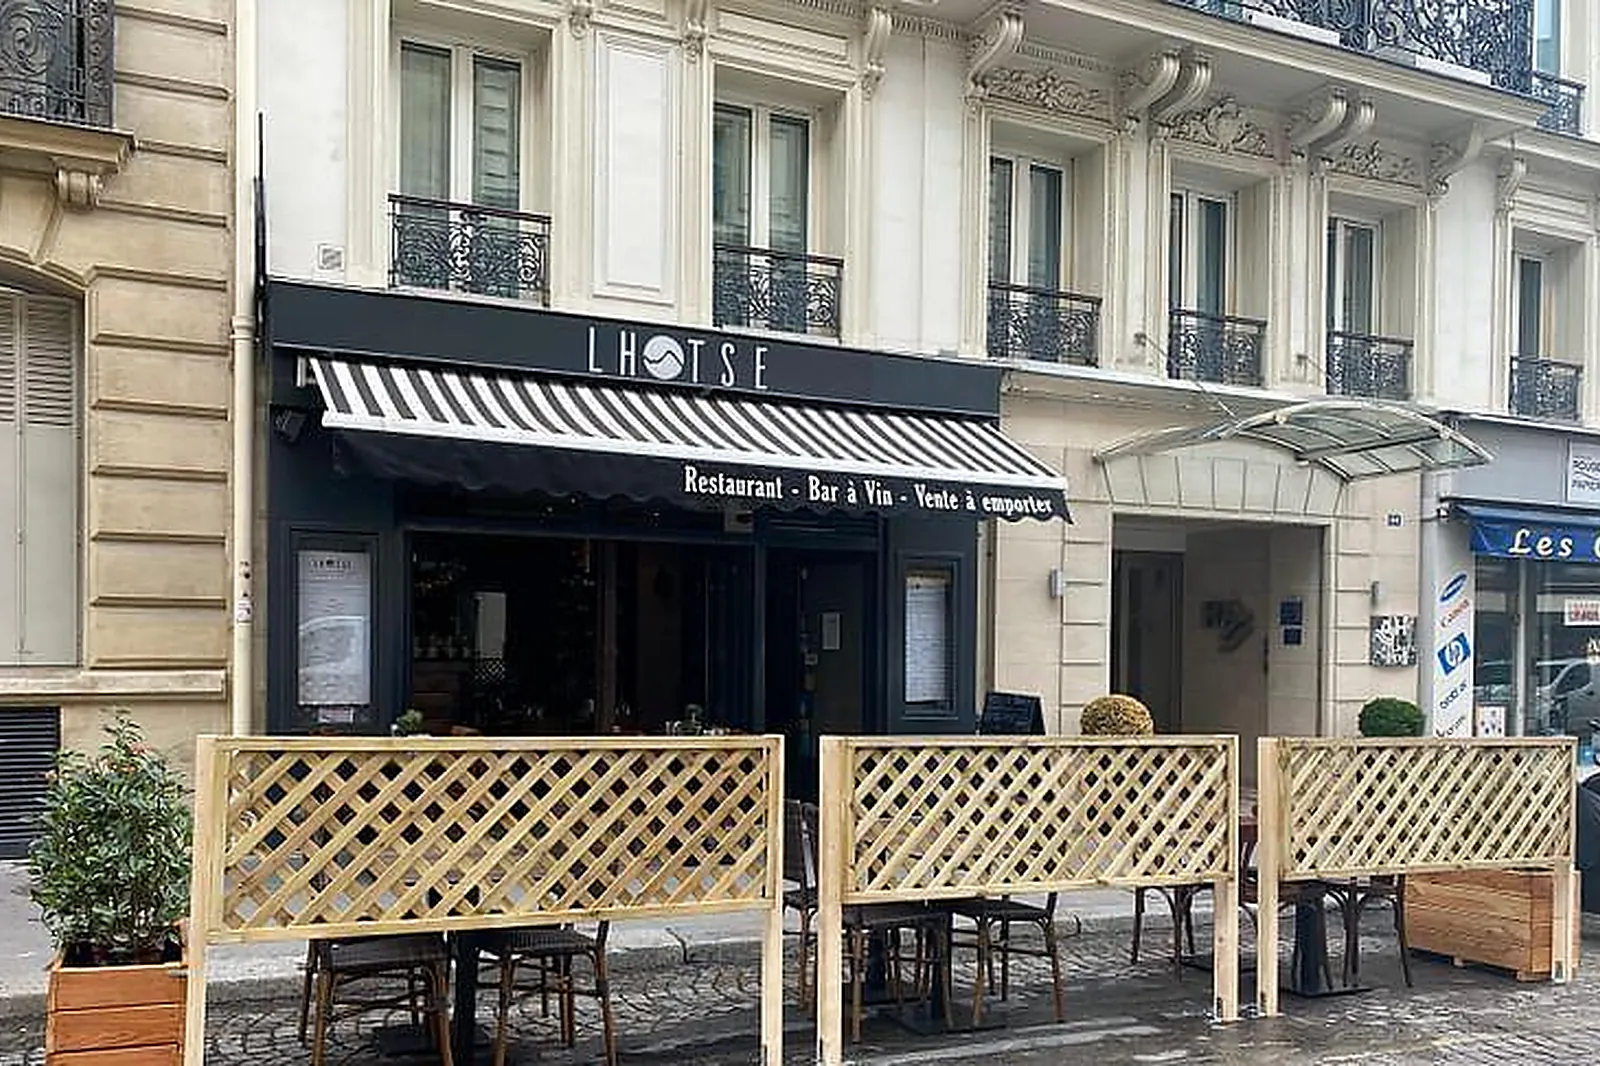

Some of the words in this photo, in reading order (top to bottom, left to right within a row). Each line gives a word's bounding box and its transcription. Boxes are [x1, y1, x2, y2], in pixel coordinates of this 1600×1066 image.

[684, 465, 783, 499] Restaurant
[808, 475, 839, 501] Bar
[847, 480, 857, 504] à
[864, 480, 893, 506] Vin
[914, 483, 959, 510] Vente
[966, 490, 976, 511] à
[982, 494, 1053, 516] emporter
[1508, 528, 1573, 557] Les
